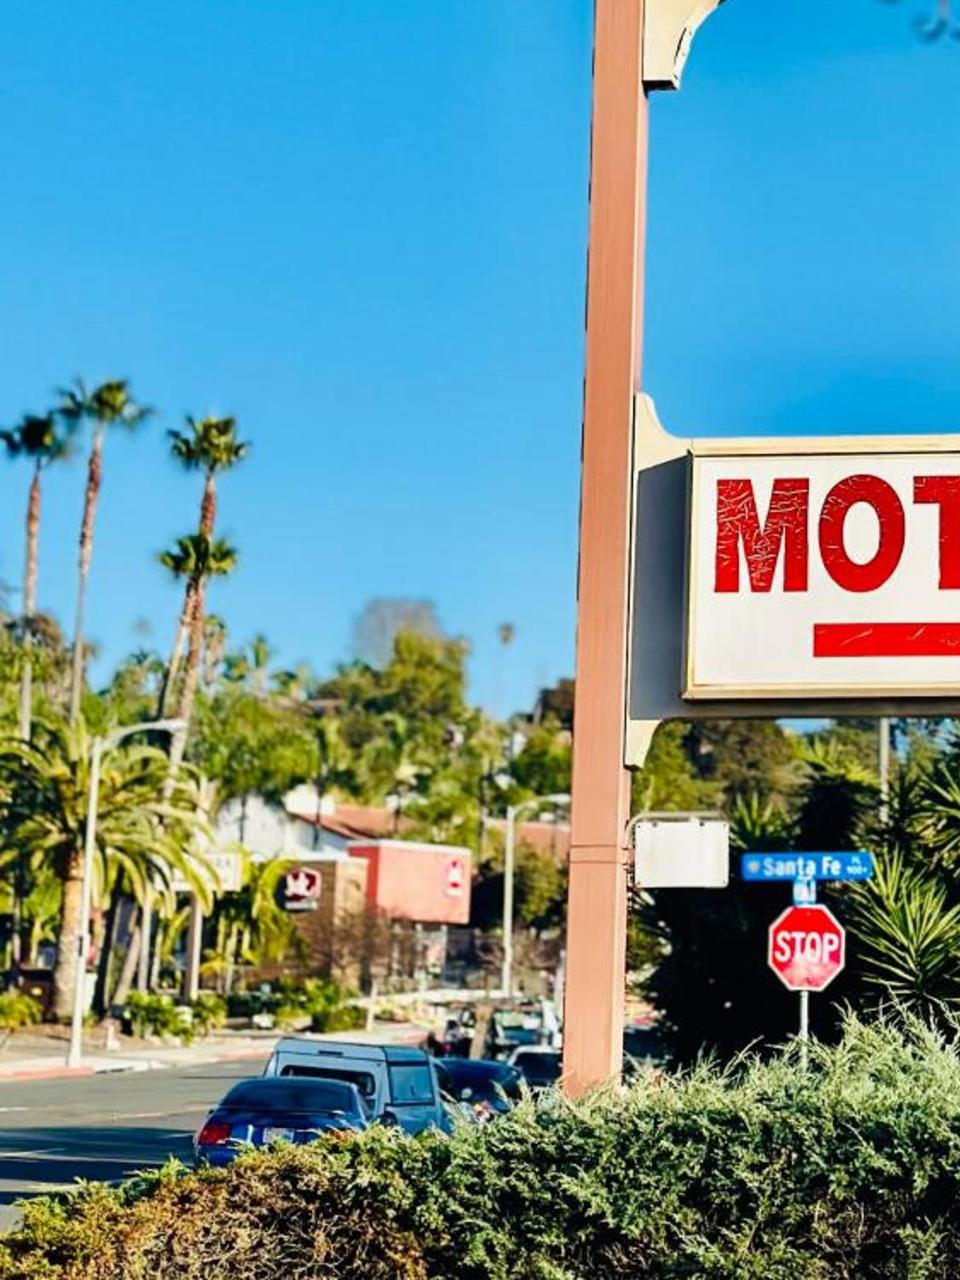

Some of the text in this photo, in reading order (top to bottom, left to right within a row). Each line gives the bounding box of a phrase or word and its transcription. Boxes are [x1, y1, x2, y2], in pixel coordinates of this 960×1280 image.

[763, 856, 841, 876] Santa Fe
[775, 931, 839, 963] STOP
